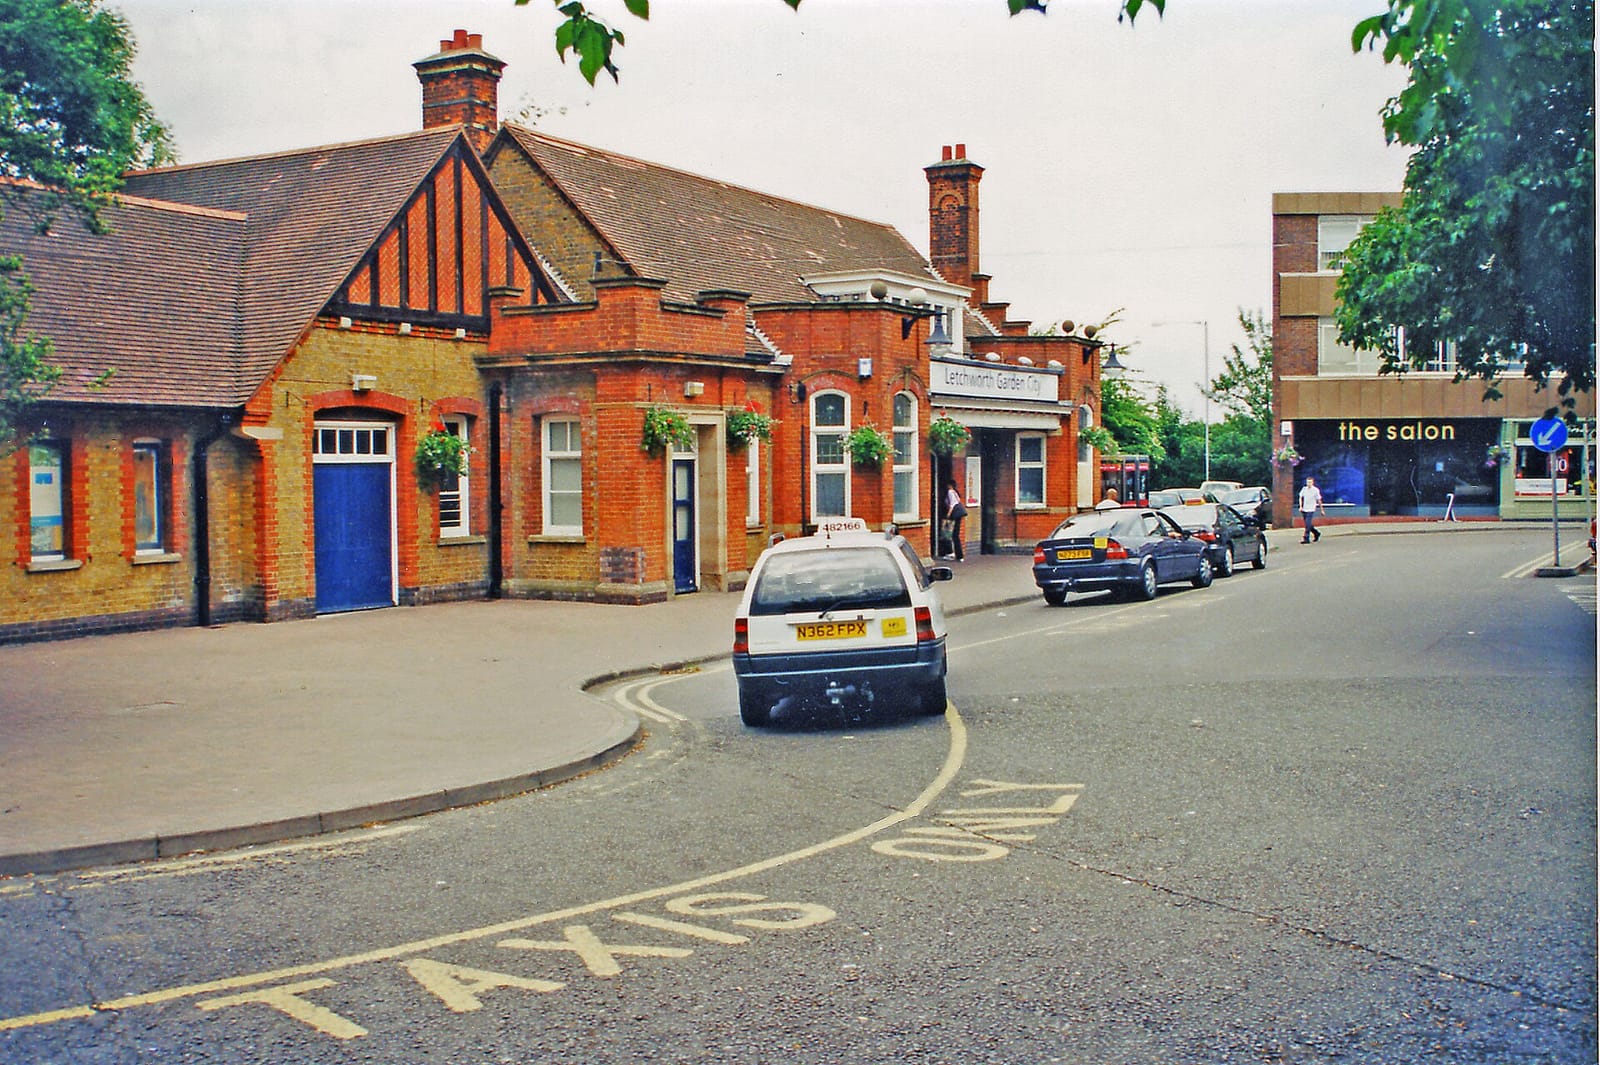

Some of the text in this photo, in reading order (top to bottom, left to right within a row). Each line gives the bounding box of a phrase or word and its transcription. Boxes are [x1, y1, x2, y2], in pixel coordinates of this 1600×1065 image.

[944, 366, 1042, 396] Letchworth Garden City
[1338, 421, 1455, 441] the salon
[823, 522, 861, 532] 482166
[798, 623, 865, 638] N362 FPX
[870, 778, 1086, 862] ONLY
[195, 892, 837, 1039] TAXIS
